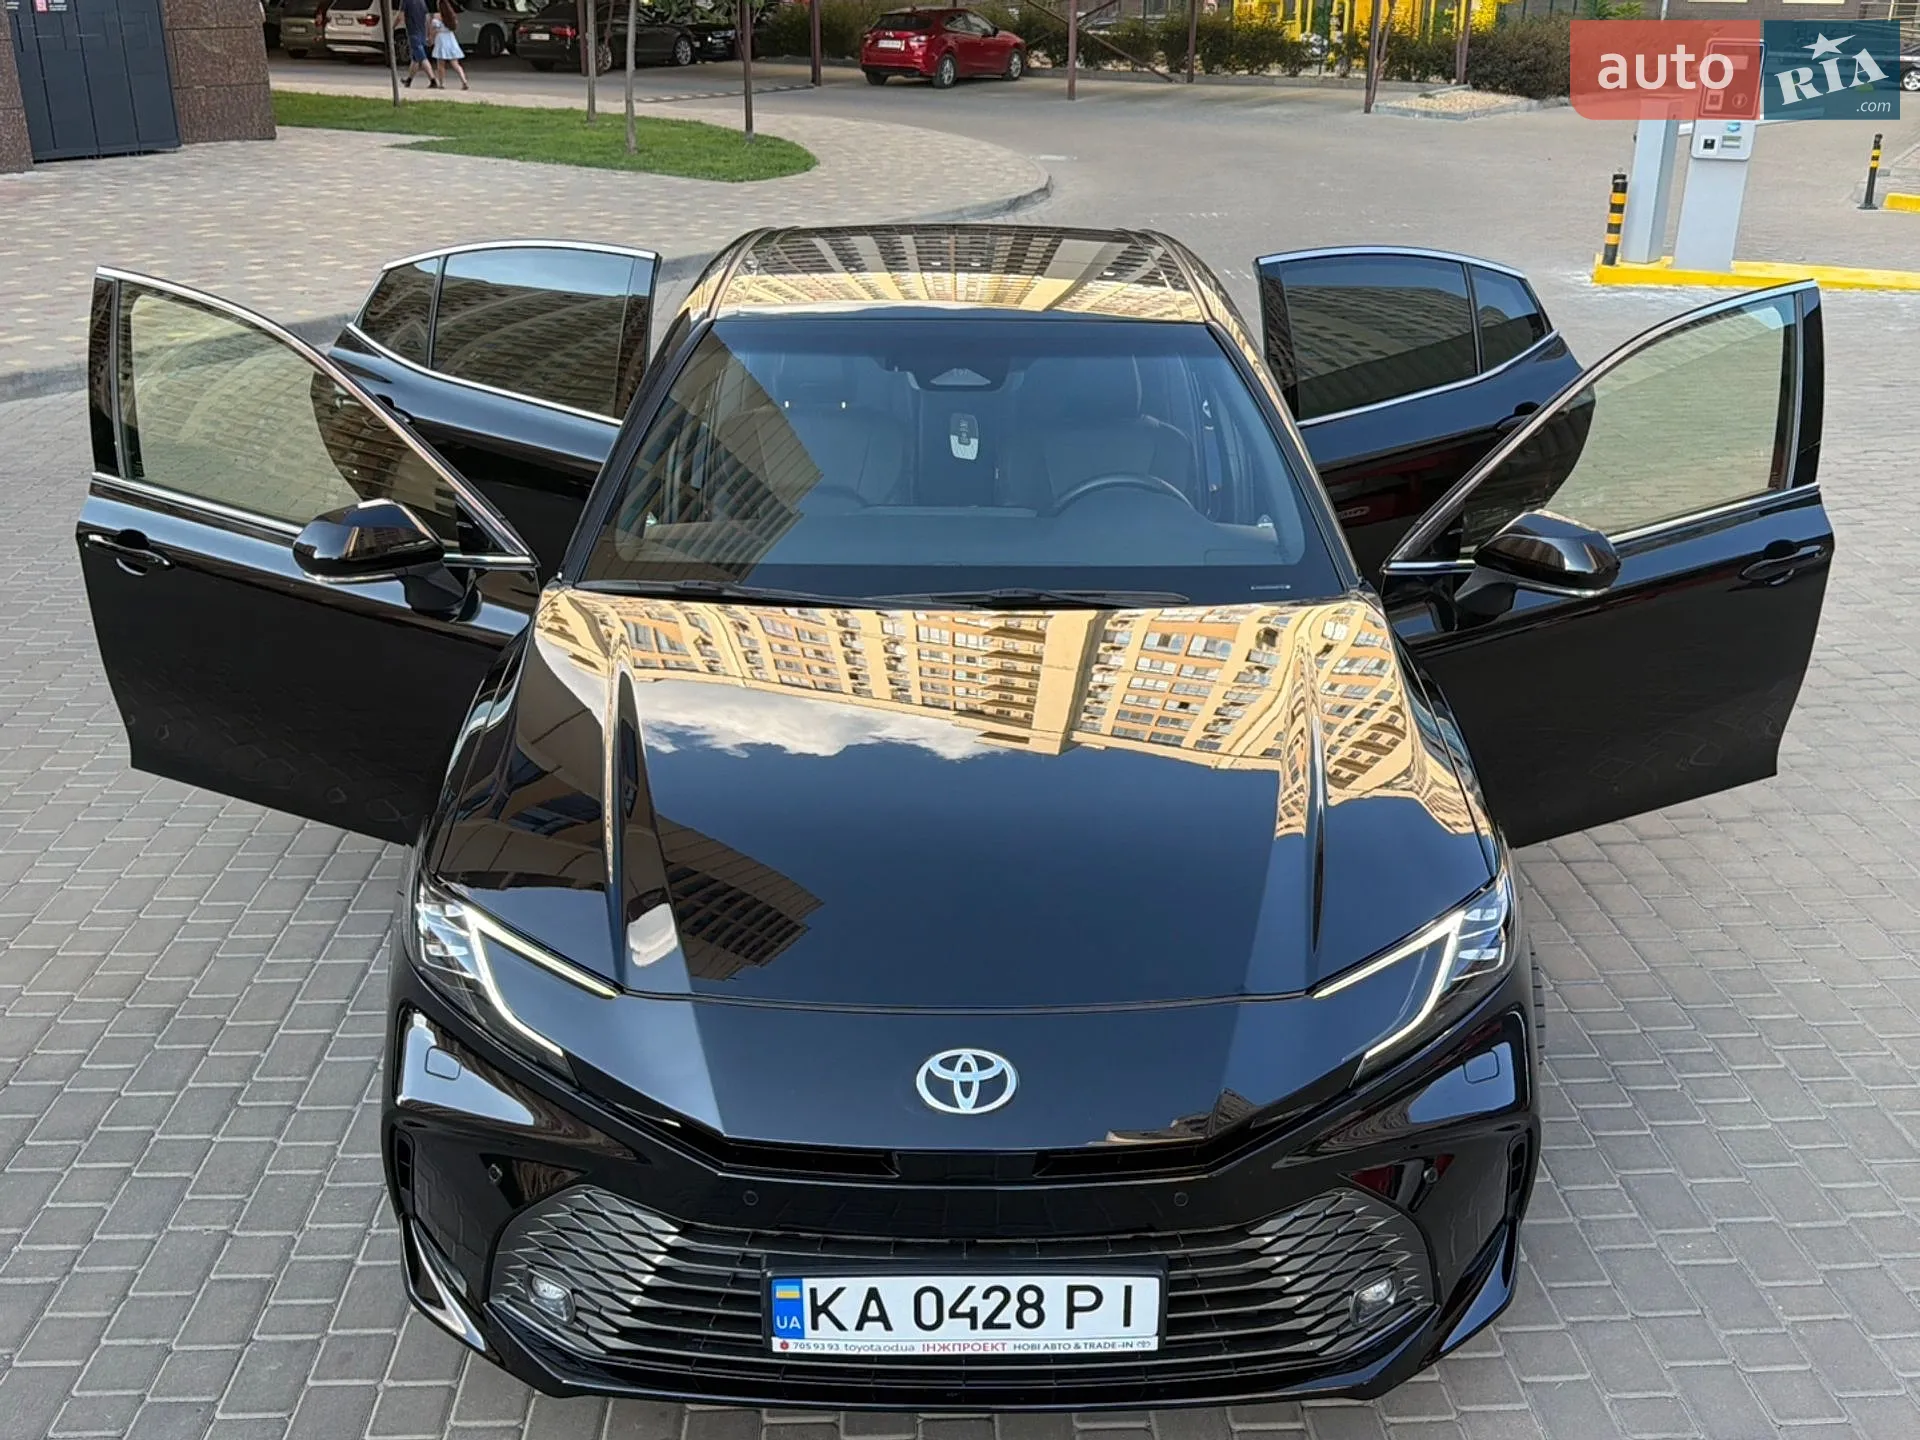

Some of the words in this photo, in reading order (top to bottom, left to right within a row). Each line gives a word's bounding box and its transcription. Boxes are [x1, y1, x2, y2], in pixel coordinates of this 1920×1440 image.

[809, 1286, 893, 1331] KA
[913, 1285, 1046, 1331] 0428
[776, 1315, 801, 1330] UA
[1083, 1341, 1134, 1349] TRADE-IN
